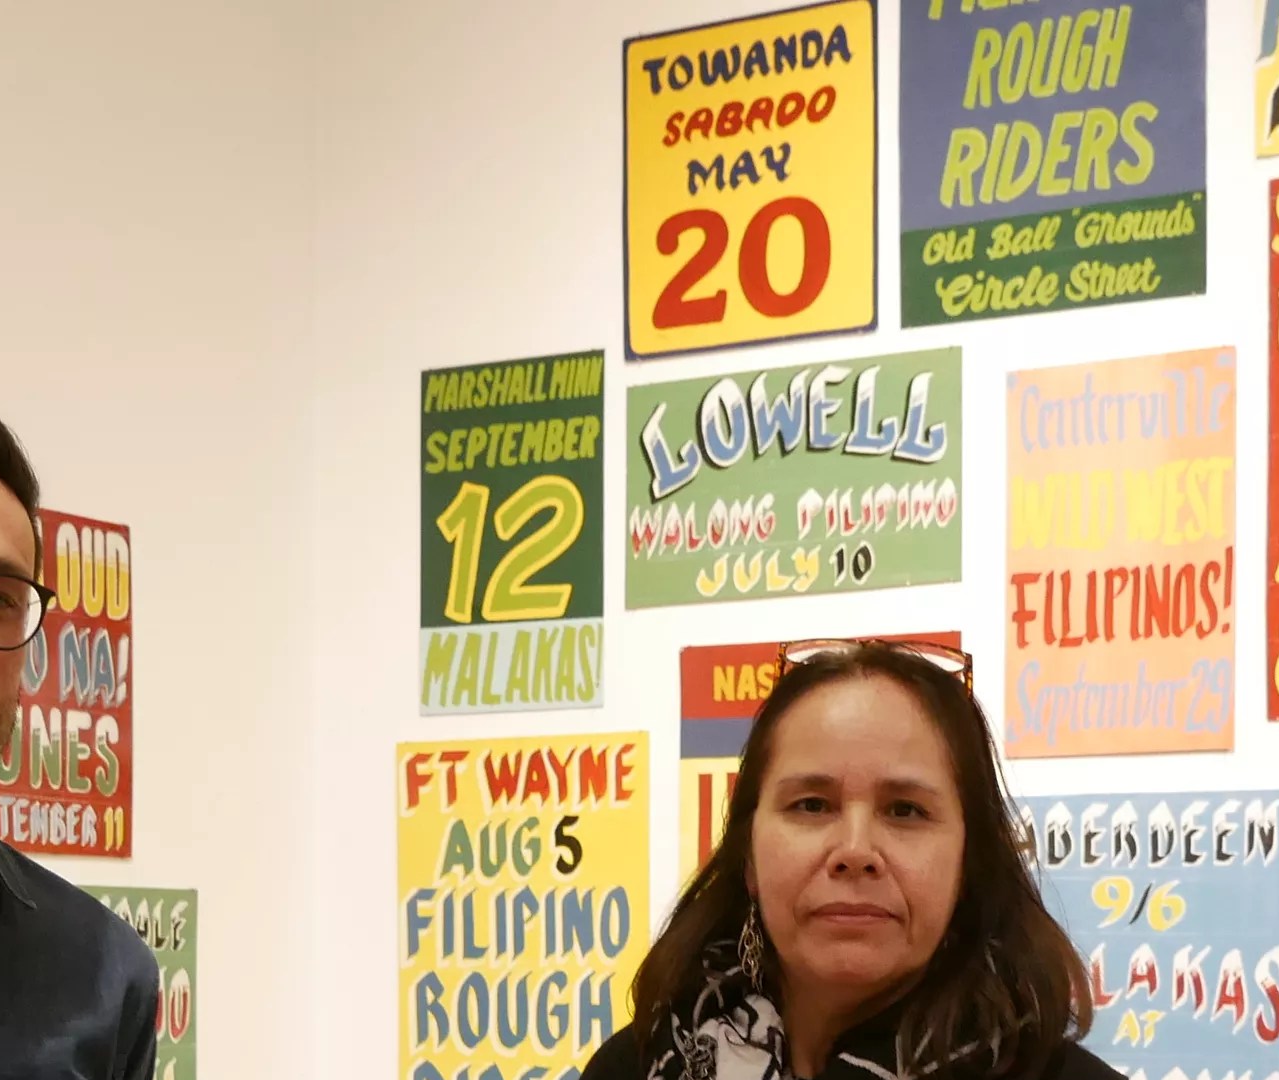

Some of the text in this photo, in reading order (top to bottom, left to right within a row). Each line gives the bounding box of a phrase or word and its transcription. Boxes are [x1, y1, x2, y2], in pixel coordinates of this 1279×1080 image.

[642, 24, 852, 95] TOWANDA
[963, 6, 1132, 109] ROUGH
[662, 85, 837, 148] SABADO
[686, 142, 792, 197] MAY
[940, 100, 1159, 208] RIDERS
[652, 196, 831, 330] 20
[922, 227, 976, 266] Old
[986, 215, 1062, 260] Ball
[935, 257, 1161, 317] Circle Street
[424, 356, 603, 413] MARSHALL MINN
[424, 416, 601, 475] SEPTEMBER
[639, 364, 948, 503] LOWELL
[629, 476, 958, 560] WALONG PILIPINO
[1011, 456, 1234, 551] WILD WEST
[436, 474, 584, 624] 12
[695, 540, 876, 597] JULY 10
[1011, 546, 1234, 649] FILIPINOS!
[58, 621, 130, 709] NA!
[421, 622, 603, 708] MALAKAS!
[1007, 657, 1231, 747] September 29
[401, 743, 636, 815] FT WAYNE
[104, 806, 124, 851] 11
[438, 814, 583, 884] AUG 5
[100, 895, 188, 951] ALE
[400, 884, 631, 967] FILIPINO
[1091, 875, 1187, 932] 9/6
[409, 969, 617, 1057] ROUGH
[1112, 1008, 1167, 1048] AT
